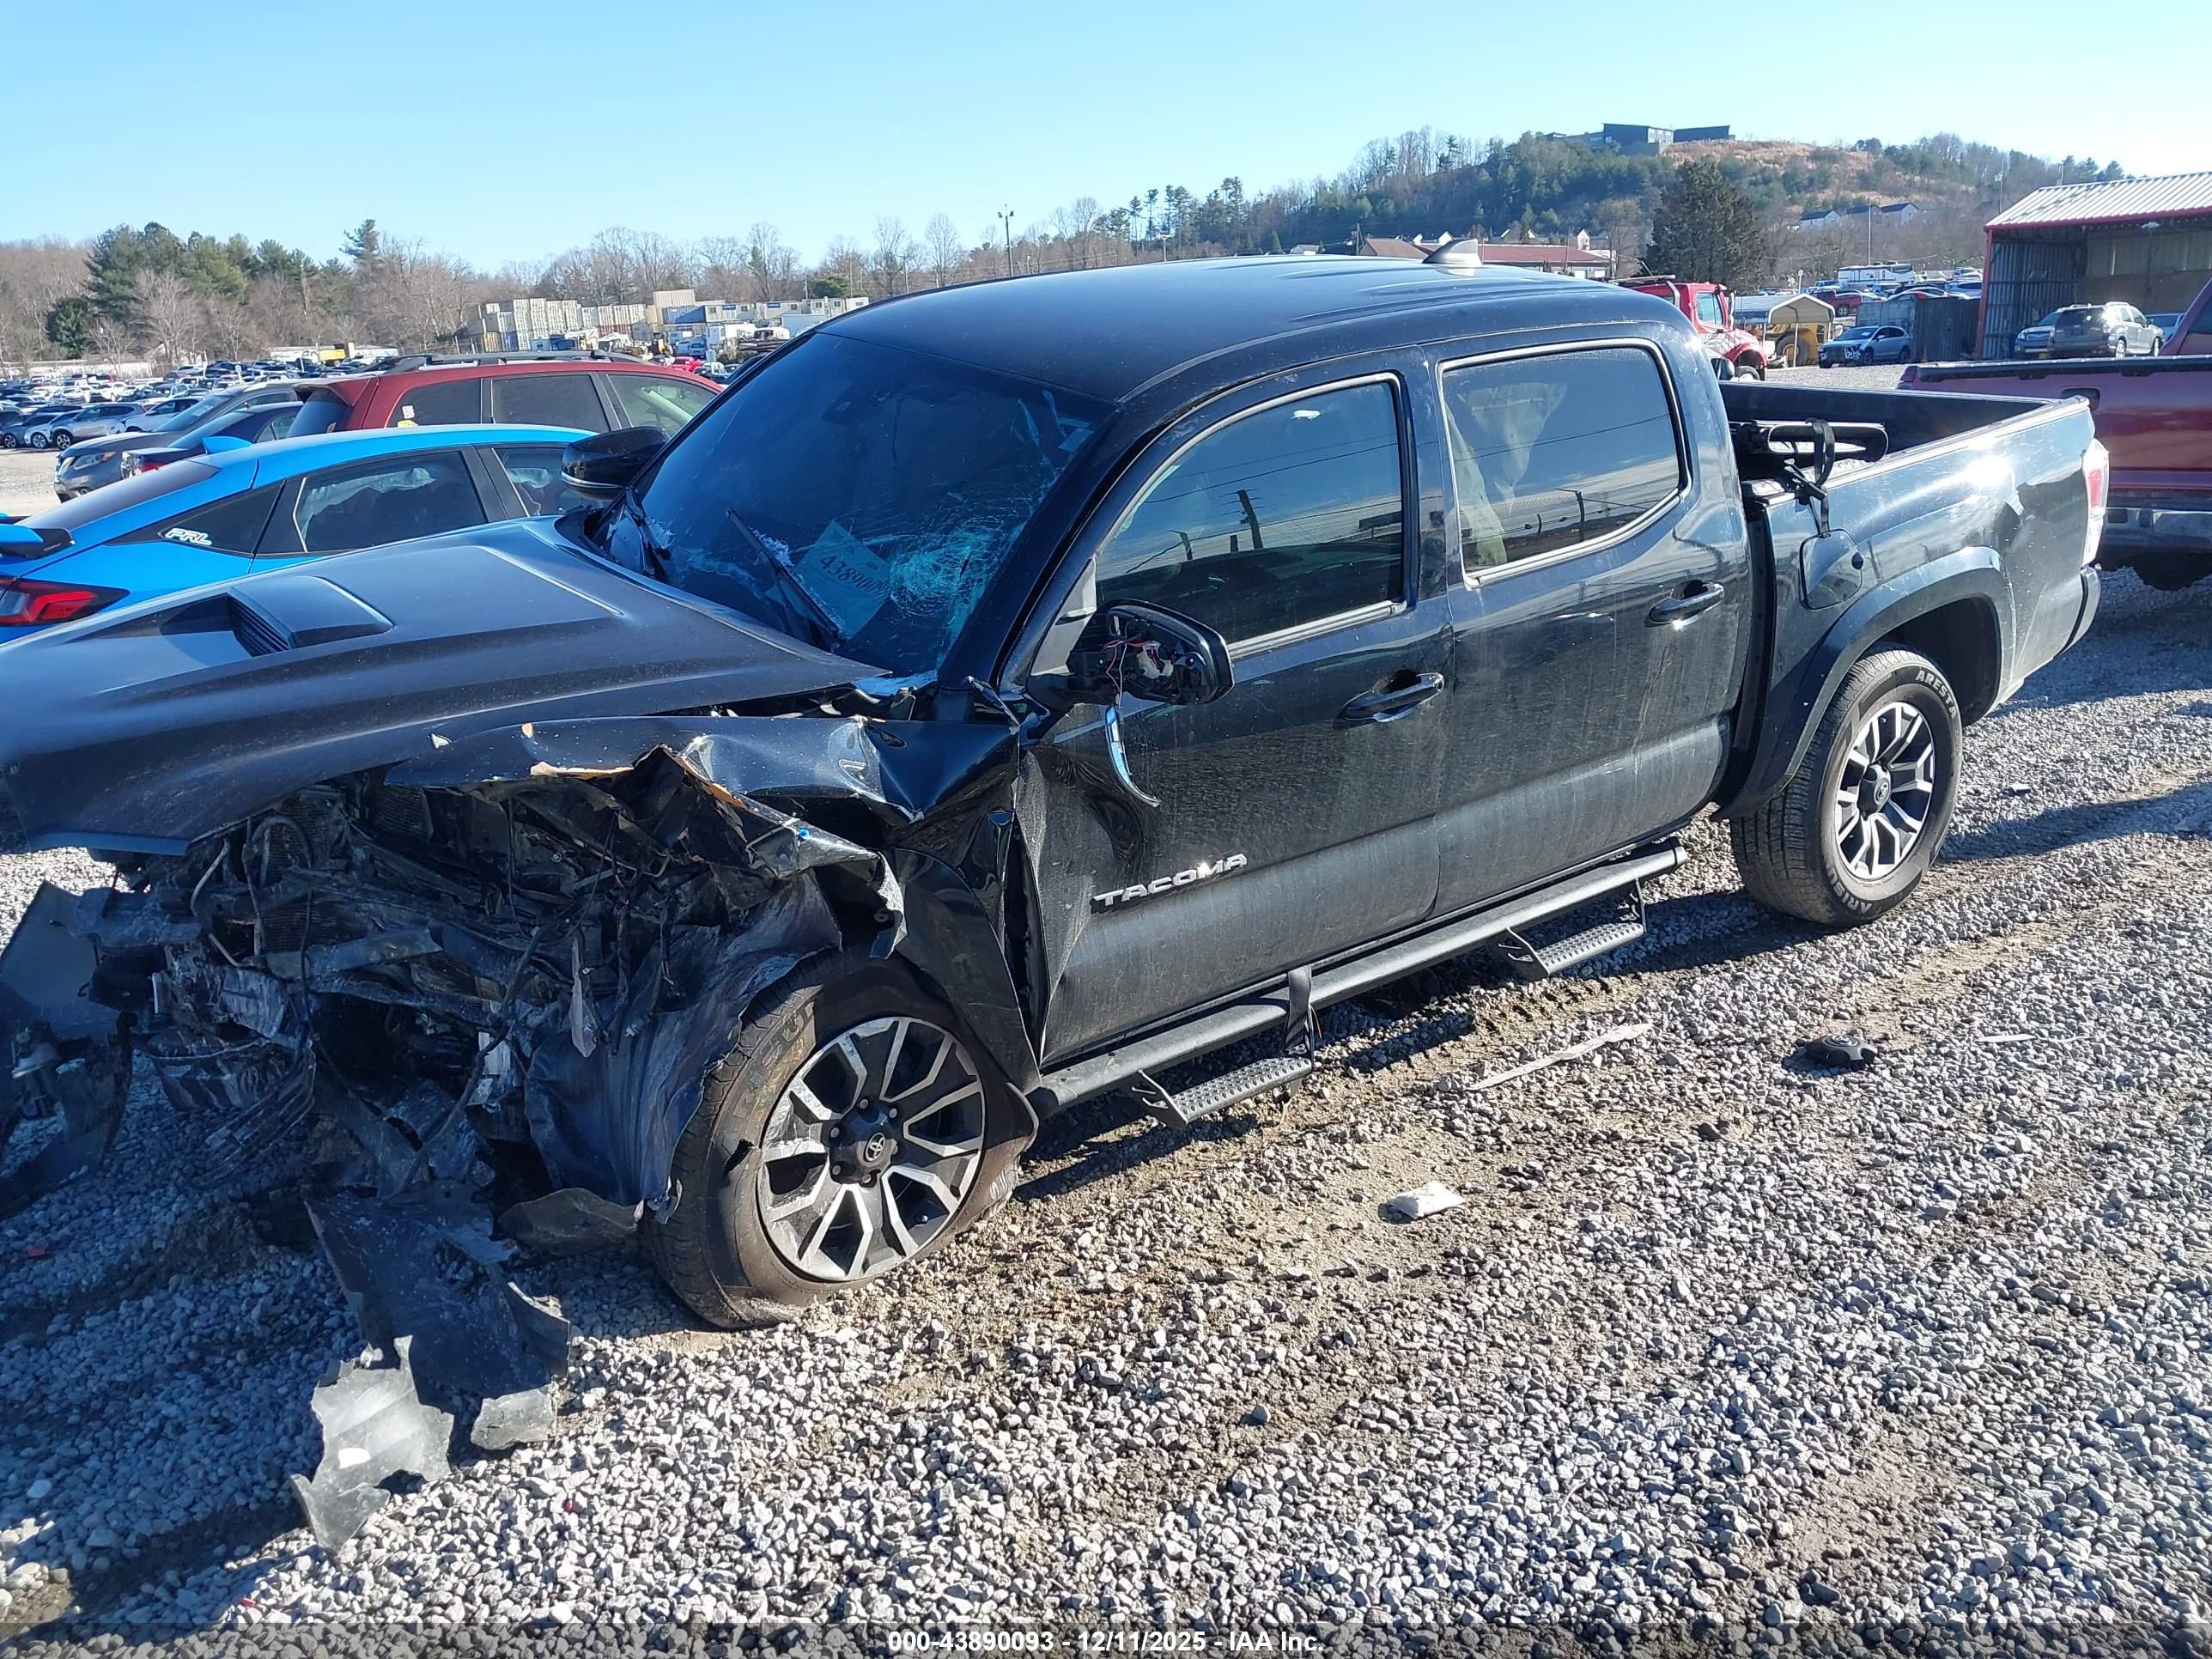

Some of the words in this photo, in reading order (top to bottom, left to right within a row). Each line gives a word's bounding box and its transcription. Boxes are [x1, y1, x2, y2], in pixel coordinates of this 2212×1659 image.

[165, 527, 213, 546] PRL
[1915, 670, 1957, 720] ARESTA
[1092, 853, 1248, 907] TACOMA
